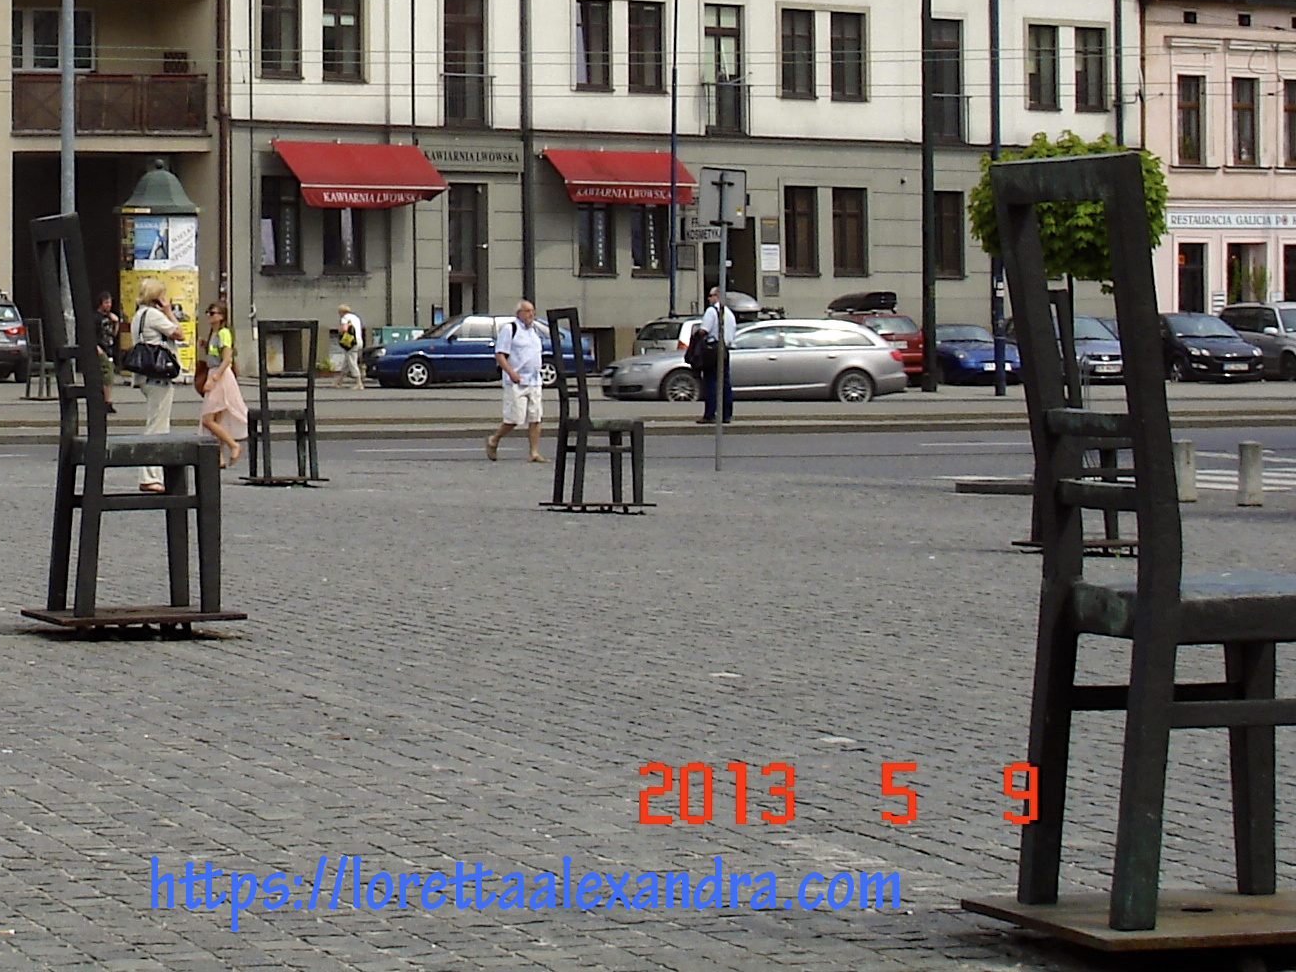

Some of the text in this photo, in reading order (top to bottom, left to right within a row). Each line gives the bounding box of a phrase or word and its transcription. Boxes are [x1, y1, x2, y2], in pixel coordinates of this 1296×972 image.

[425, 150, 519, 163] KAWIARNIA LWOWSKA
[323, 192, 422, 203] KAWIARNIA LWOWSKA
[576, 188, 672, 200] KAWIARNIA LWOWSKA
[1236, 215, 1271, 225] GALICIA
